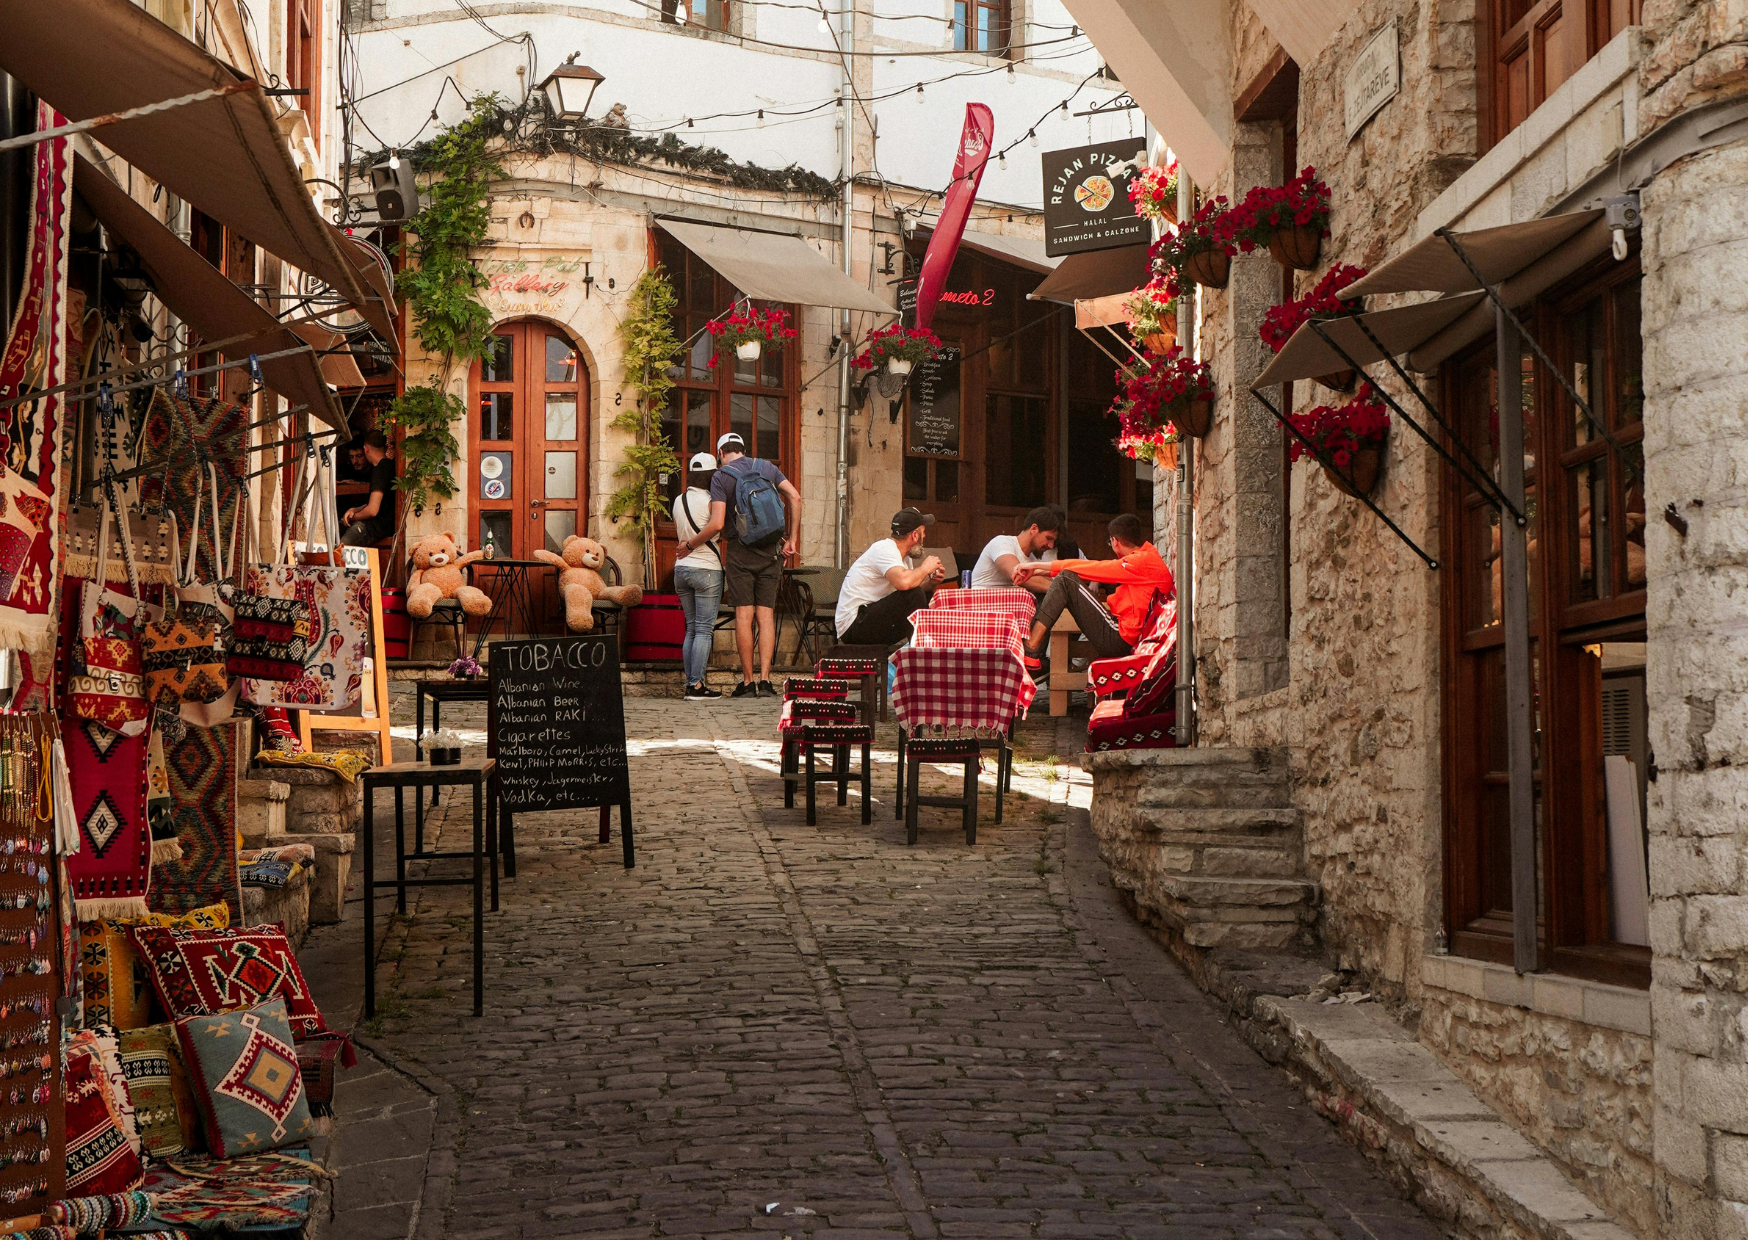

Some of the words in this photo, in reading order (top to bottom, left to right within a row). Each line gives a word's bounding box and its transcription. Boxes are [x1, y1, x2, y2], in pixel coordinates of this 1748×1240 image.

[1051, 158, 1084, 205] REJAN
[1083, 218, 1107, 227] HALAL
[1053, 233, 1094, 244] SANDWICH
[1105, 226, 1140, 237] CALZONE
[481, 255, 529, 273] Irish
[540, 255, 583, 273] Pub
[488, 274, 569, 297] Gallery
[982, 288, 995, 306] 2
[501, 641, 606, 671] TOBACCO
[497, 678, 545, 693] Albanian
[496, 694, 546, 710] Albanian
[499, 711, 547, 723] Albanian
[498, 727, 571, 749] Cigarettes
